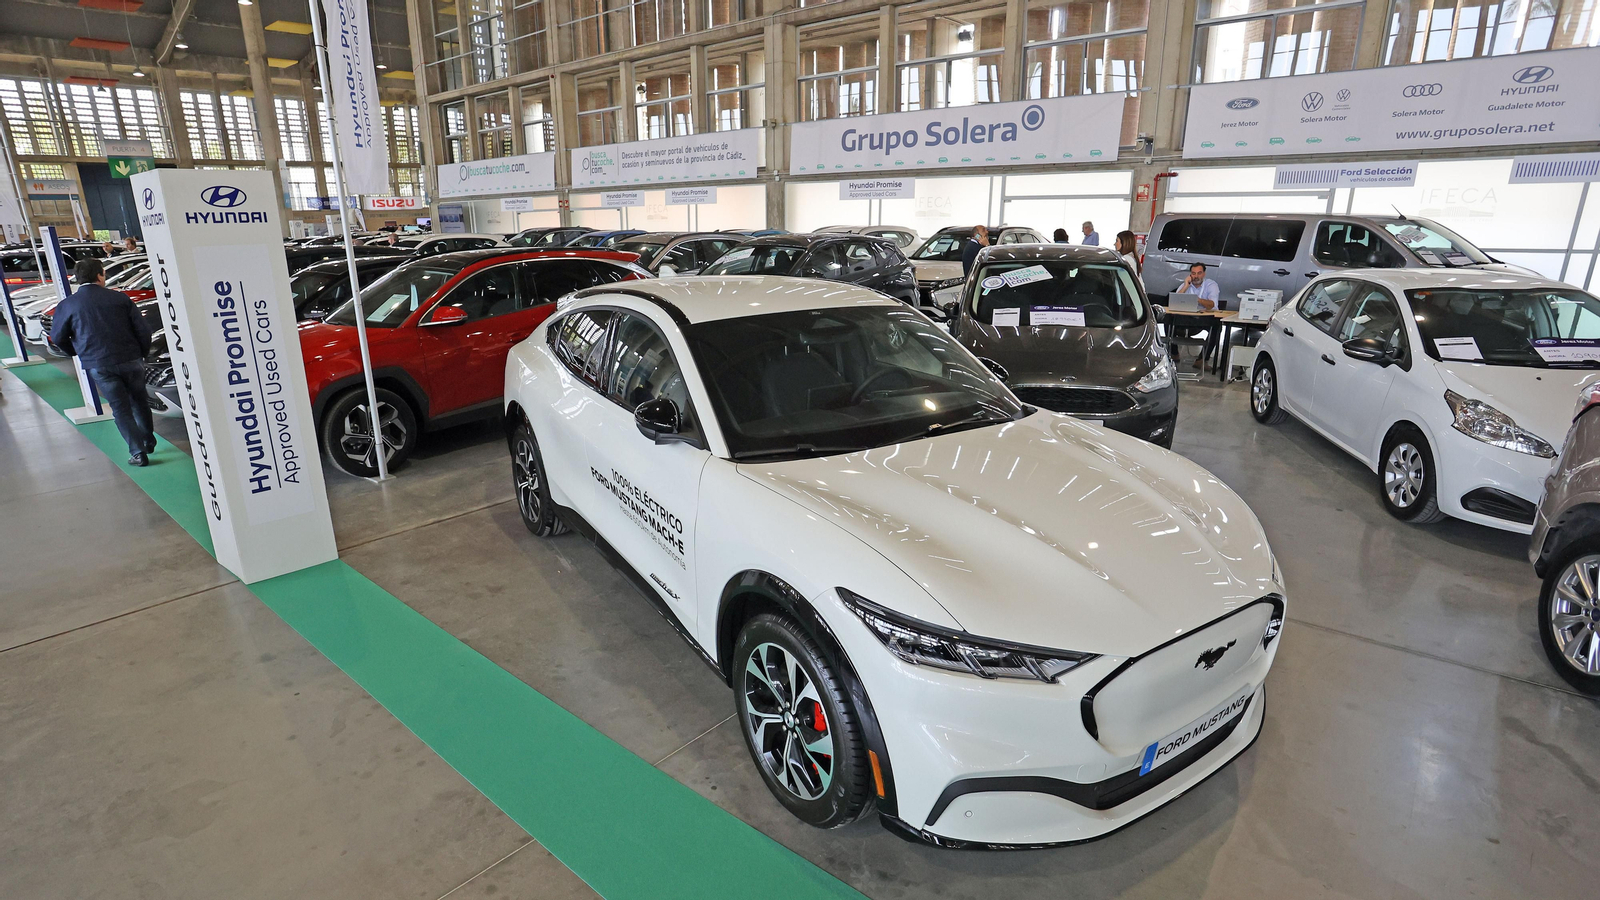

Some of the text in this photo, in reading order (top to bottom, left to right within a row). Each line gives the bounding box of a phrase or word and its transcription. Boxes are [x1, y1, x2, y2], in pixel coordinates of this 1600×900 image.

[1500, 84, 1560, 97] HYUNDAI
[343, 54, 364, 149] Hyundai
[357, 70, 372, 149] Approved
[1232, 99, 1253, 109] Ford
[1487, 100, 1566, 112] Guadalete Motor
[1300, 116, 1323, 124] Solera
[1392, 108, 1445, 118] Solera Motor
[841, 117, 1018, 155] Grupo Solera
[1396, 121, 1556, 140] www.gruposolera.net
[591, 150, 607, 159] busca
[621, 151, 644, 160] Descubre
[650, 149, 667, 158] mayor
[667, 146, 684, 157] portal
[692, 143, 720, 153] vehículos
[720, 142, 729, 150] de
[621, 160, 640, 169] ocasión
[640, 161, 644, 169] y
[644, 158, 675, 167] seminuevos
[683, 156, 690, 164] la
[690, 154, 716, 164] provincia
[716, 153, 725, 161] de
[1340, 167, 1413, 176] Ford Selección
[372, 199, 415, 208] ISUZU
[915, 196, 953, 208] IFECA
[1420, 187, 1498, 204] IFECA
[142, 213, 166, 227] HYUNDAI
[185, 211, 268, 224] HYUNDAI
[1004, 268, 1031, 277] busca
[156, 253, 222, 521] Guadalete Motor
[213, 280, 272, 494] Hyundai Promise
[253, 299, 300, 484] Approved Used Cars
[611, 468, 683, 534] 100% ELÉCTRICO
[590, 466, 684, 556] FORD MUSTANG MACH-E
[1156, 732, 1191, 760] FORD
[1191, 695, 1245, 739] MUSTANG
